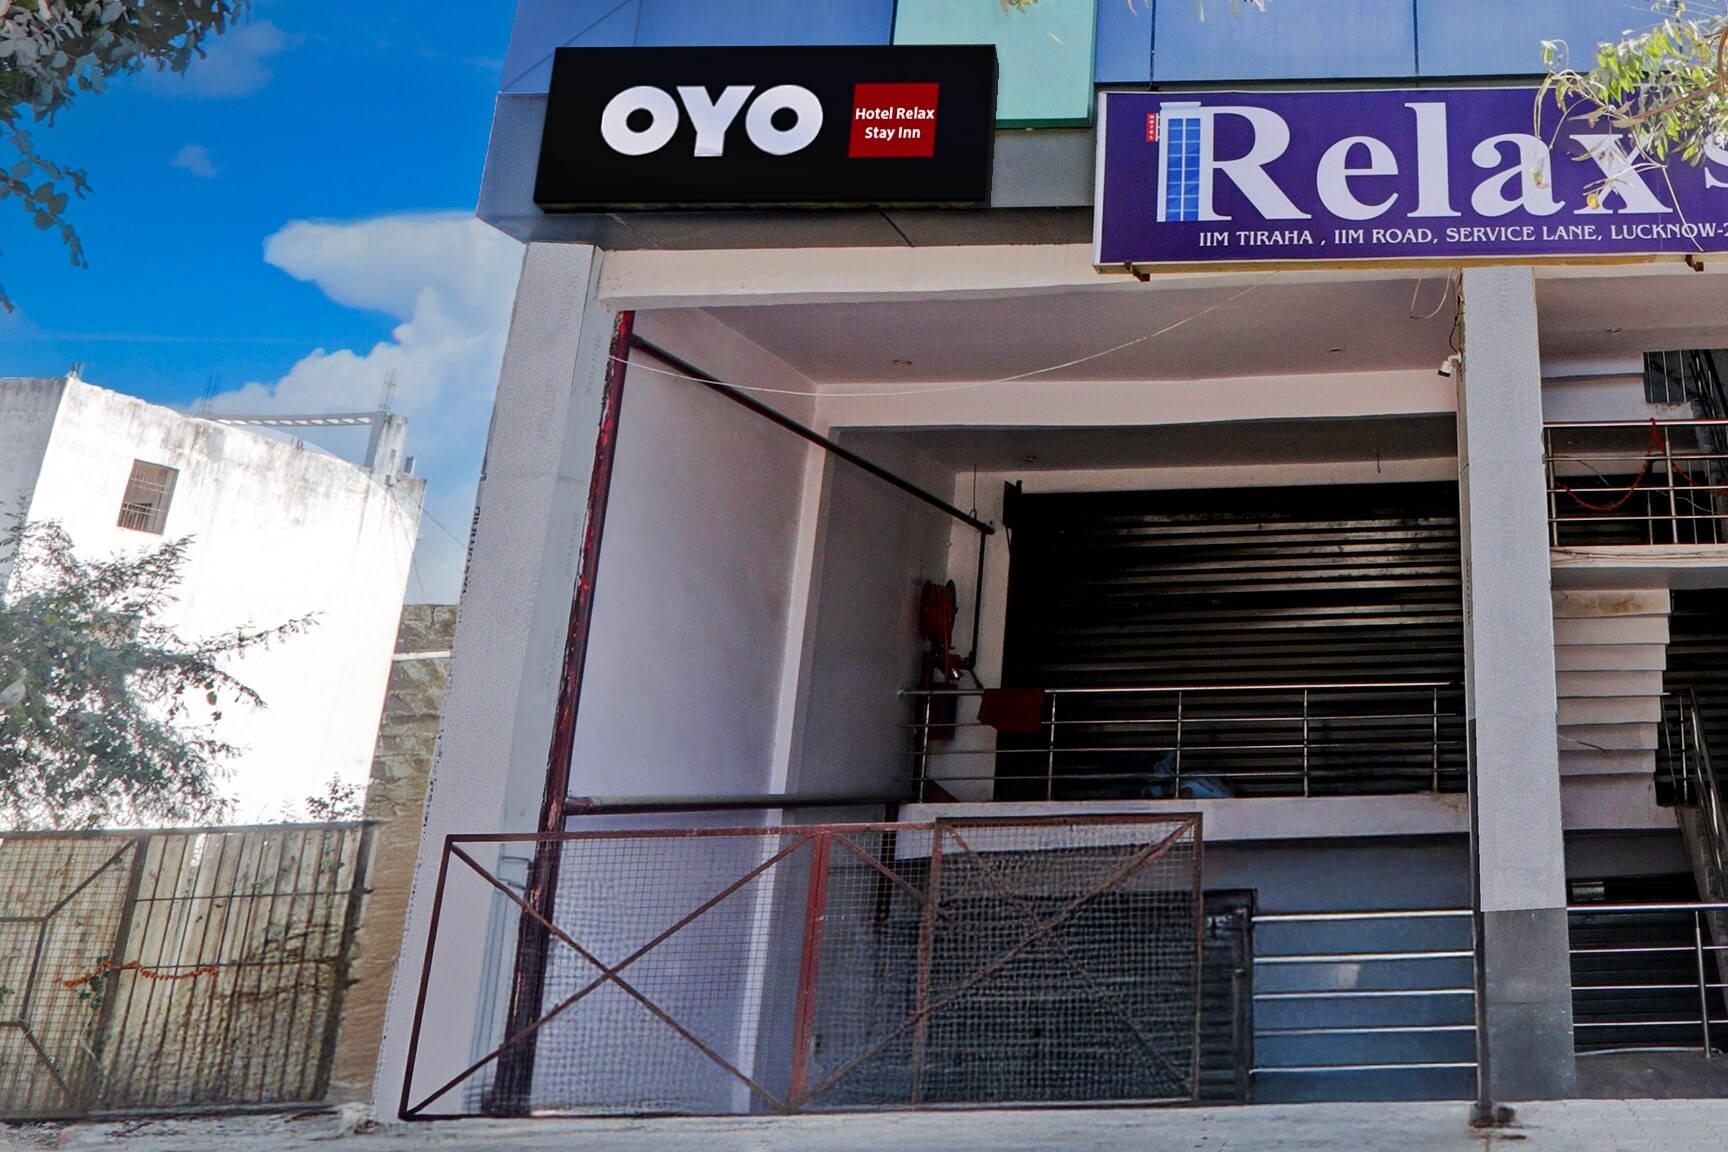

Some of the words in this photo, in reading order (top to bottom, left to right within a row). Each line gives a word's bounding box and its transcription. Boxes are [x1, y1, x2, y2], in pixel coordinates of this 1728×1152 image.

[600, 84, 823, 157] OYO
[855, 106, 893, 120] Hotel
[896, 106, 935, 120] Relax
[865, 127, 895, 141] Stay
[898, 127, 921, 139] Inn
[1197, 101, 1674, 222] Relax
[1199, 232, 1229, 247] IIM
[1236, 230, 1314, 246] TIRAHA
[1334, 229, 1364, 244] IIM
[1372, 228, 1439, 245] ROAD,
[1446, 226, 1536, 242] SERVICE
[1543, 224, 1603, 242] LANE,
